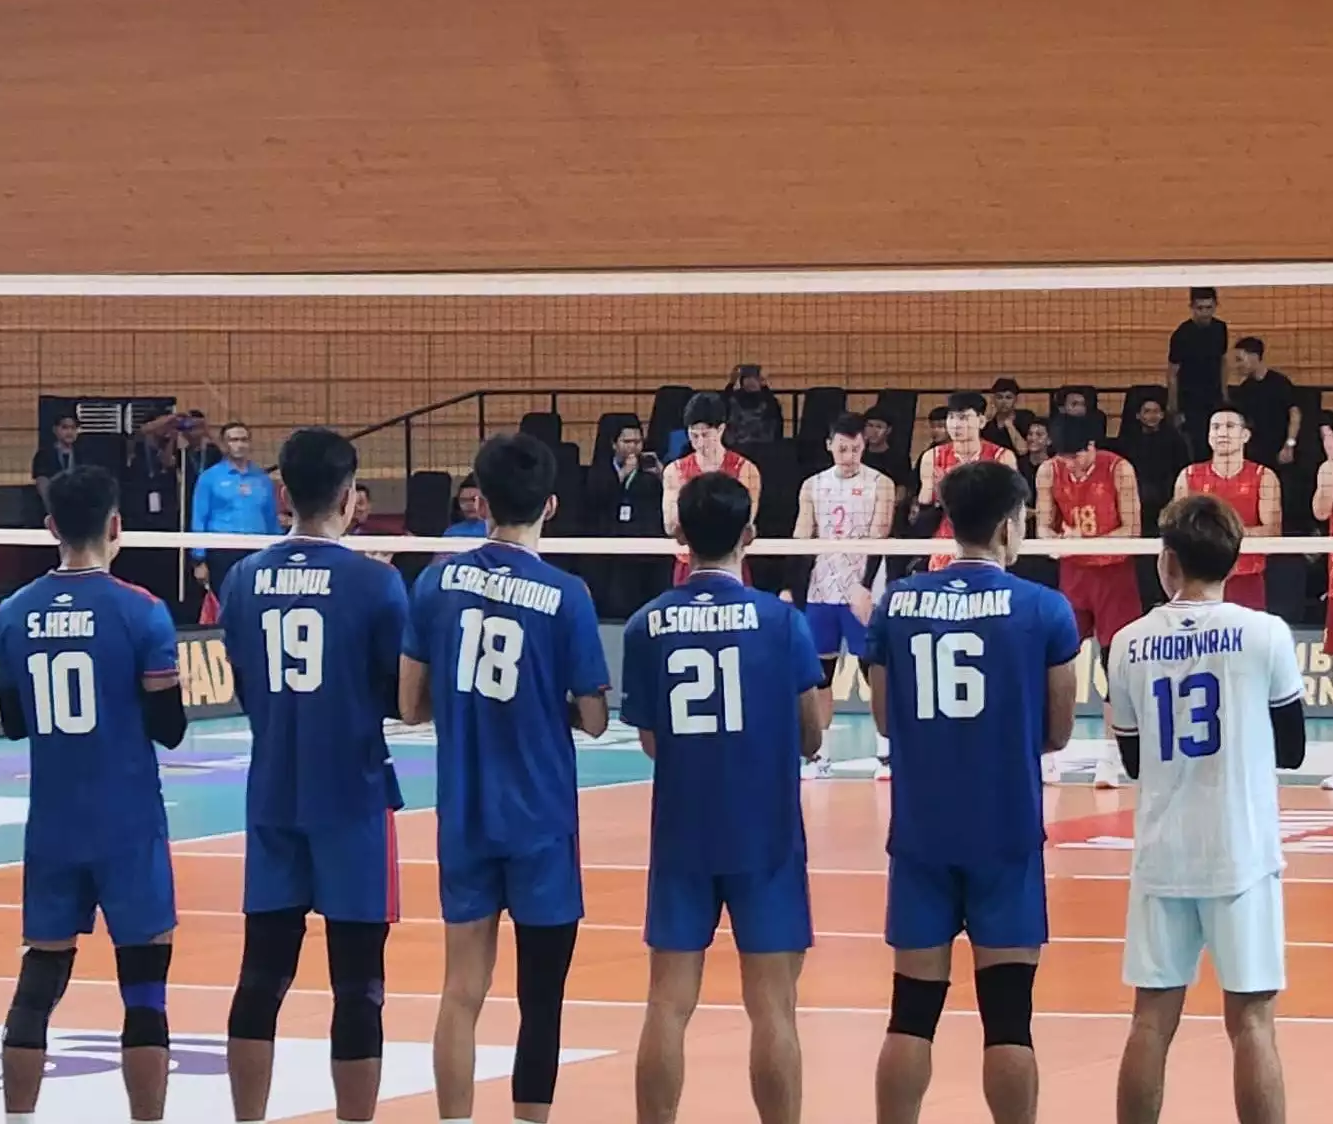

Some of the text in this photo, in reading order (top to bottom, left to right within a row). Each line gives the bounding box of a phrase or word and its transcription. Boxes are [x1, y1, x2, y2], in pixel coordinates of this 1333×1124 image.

[254, 568, 331, 594] M.NIMUL
[648, 603, 759, 637] R.SOKCHEA
[888, 589, 1012, 621] PH.RATANAK
[28, 611, 95, 638] S.HENG
[262, 608, 323, 692] 19
[457, 608, 524, 702] 18
[28, 651, 96, 734] 10
[668, 646, 743, 734] 21
[911, 632, 985, 719] 16
[1153, 672, 1222, 761] 13
